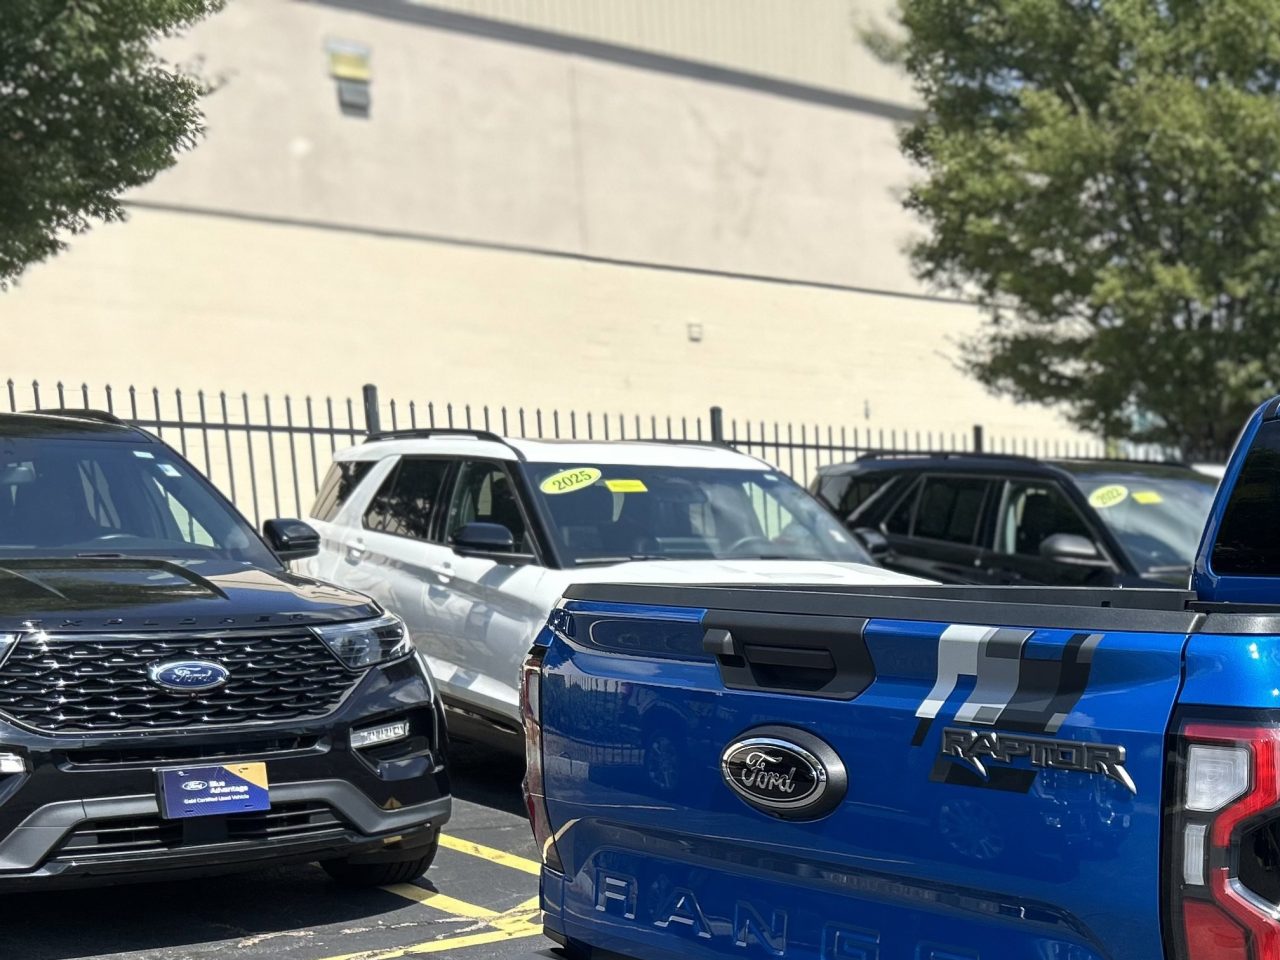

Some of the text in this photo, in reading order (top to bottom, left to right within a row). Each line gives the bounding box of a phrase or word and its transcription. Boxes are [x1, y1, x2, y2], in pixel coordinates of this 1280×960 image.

[552, 470, 592, 491] 2025
[171, 666, 213, 682] Ford
[942, 726, 1138, 796] RAPTOR
[741, 751, 797, 794] Ford
[210, 785, 249, 794] Advantage
